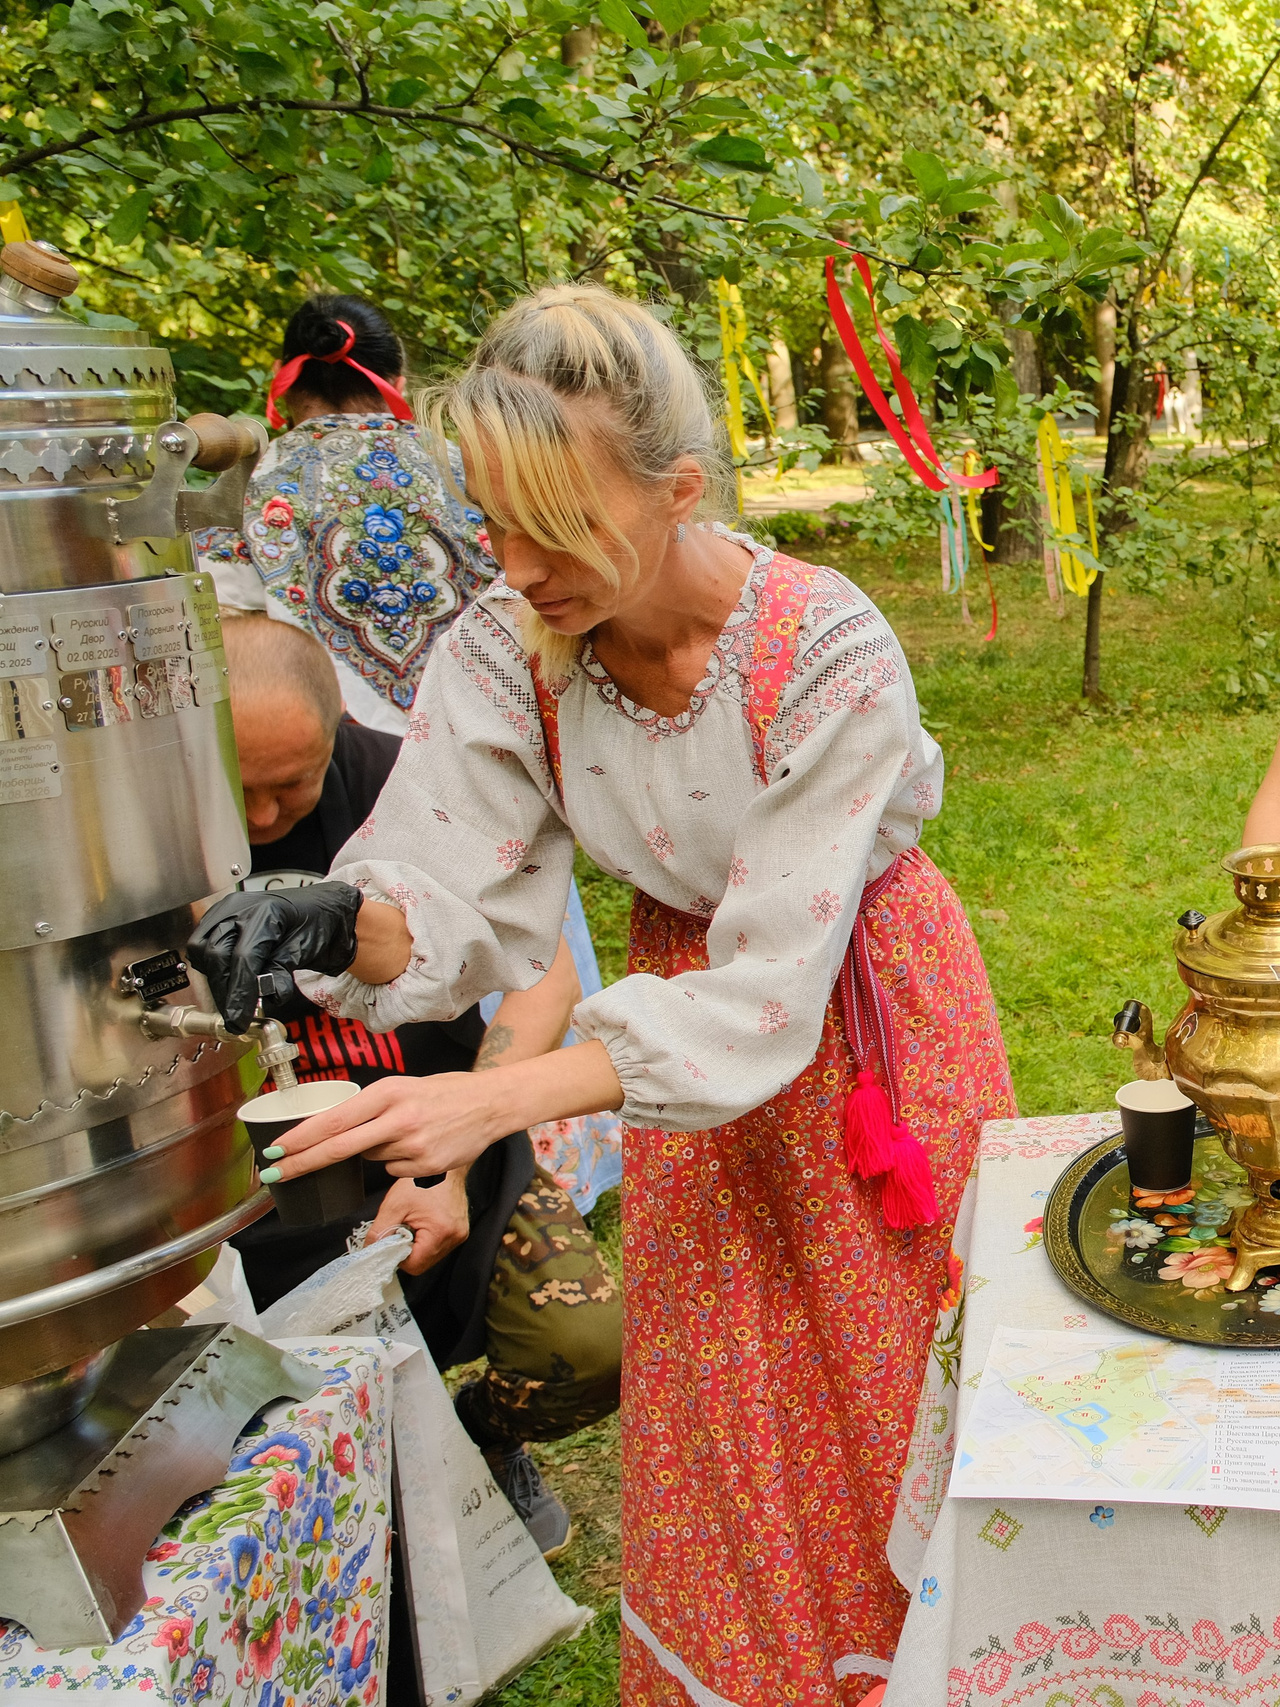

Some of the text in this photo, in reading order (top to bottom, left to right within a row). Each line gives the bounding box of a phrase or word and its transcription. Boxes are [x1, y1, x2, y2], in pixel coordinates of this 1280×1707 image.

[137, 605, 175, 618] Похороны
[193, 601, 212, 613] Русский
[70, 616, 110, 631] Русский
[143, 624, 175, 638] Арсения
[80, 634, 105, 647] Двор
[67, 648, 120, 663] 02.08.2025
[142, 641, 181, 657] 27.08.2025
[74, 674, 119, 691] Руссий
[18, 743, 54, 754] футболу
[1223, 1485, 1270, 1493] Эвакуационный
[462, 1487, 482, 1517] 40
